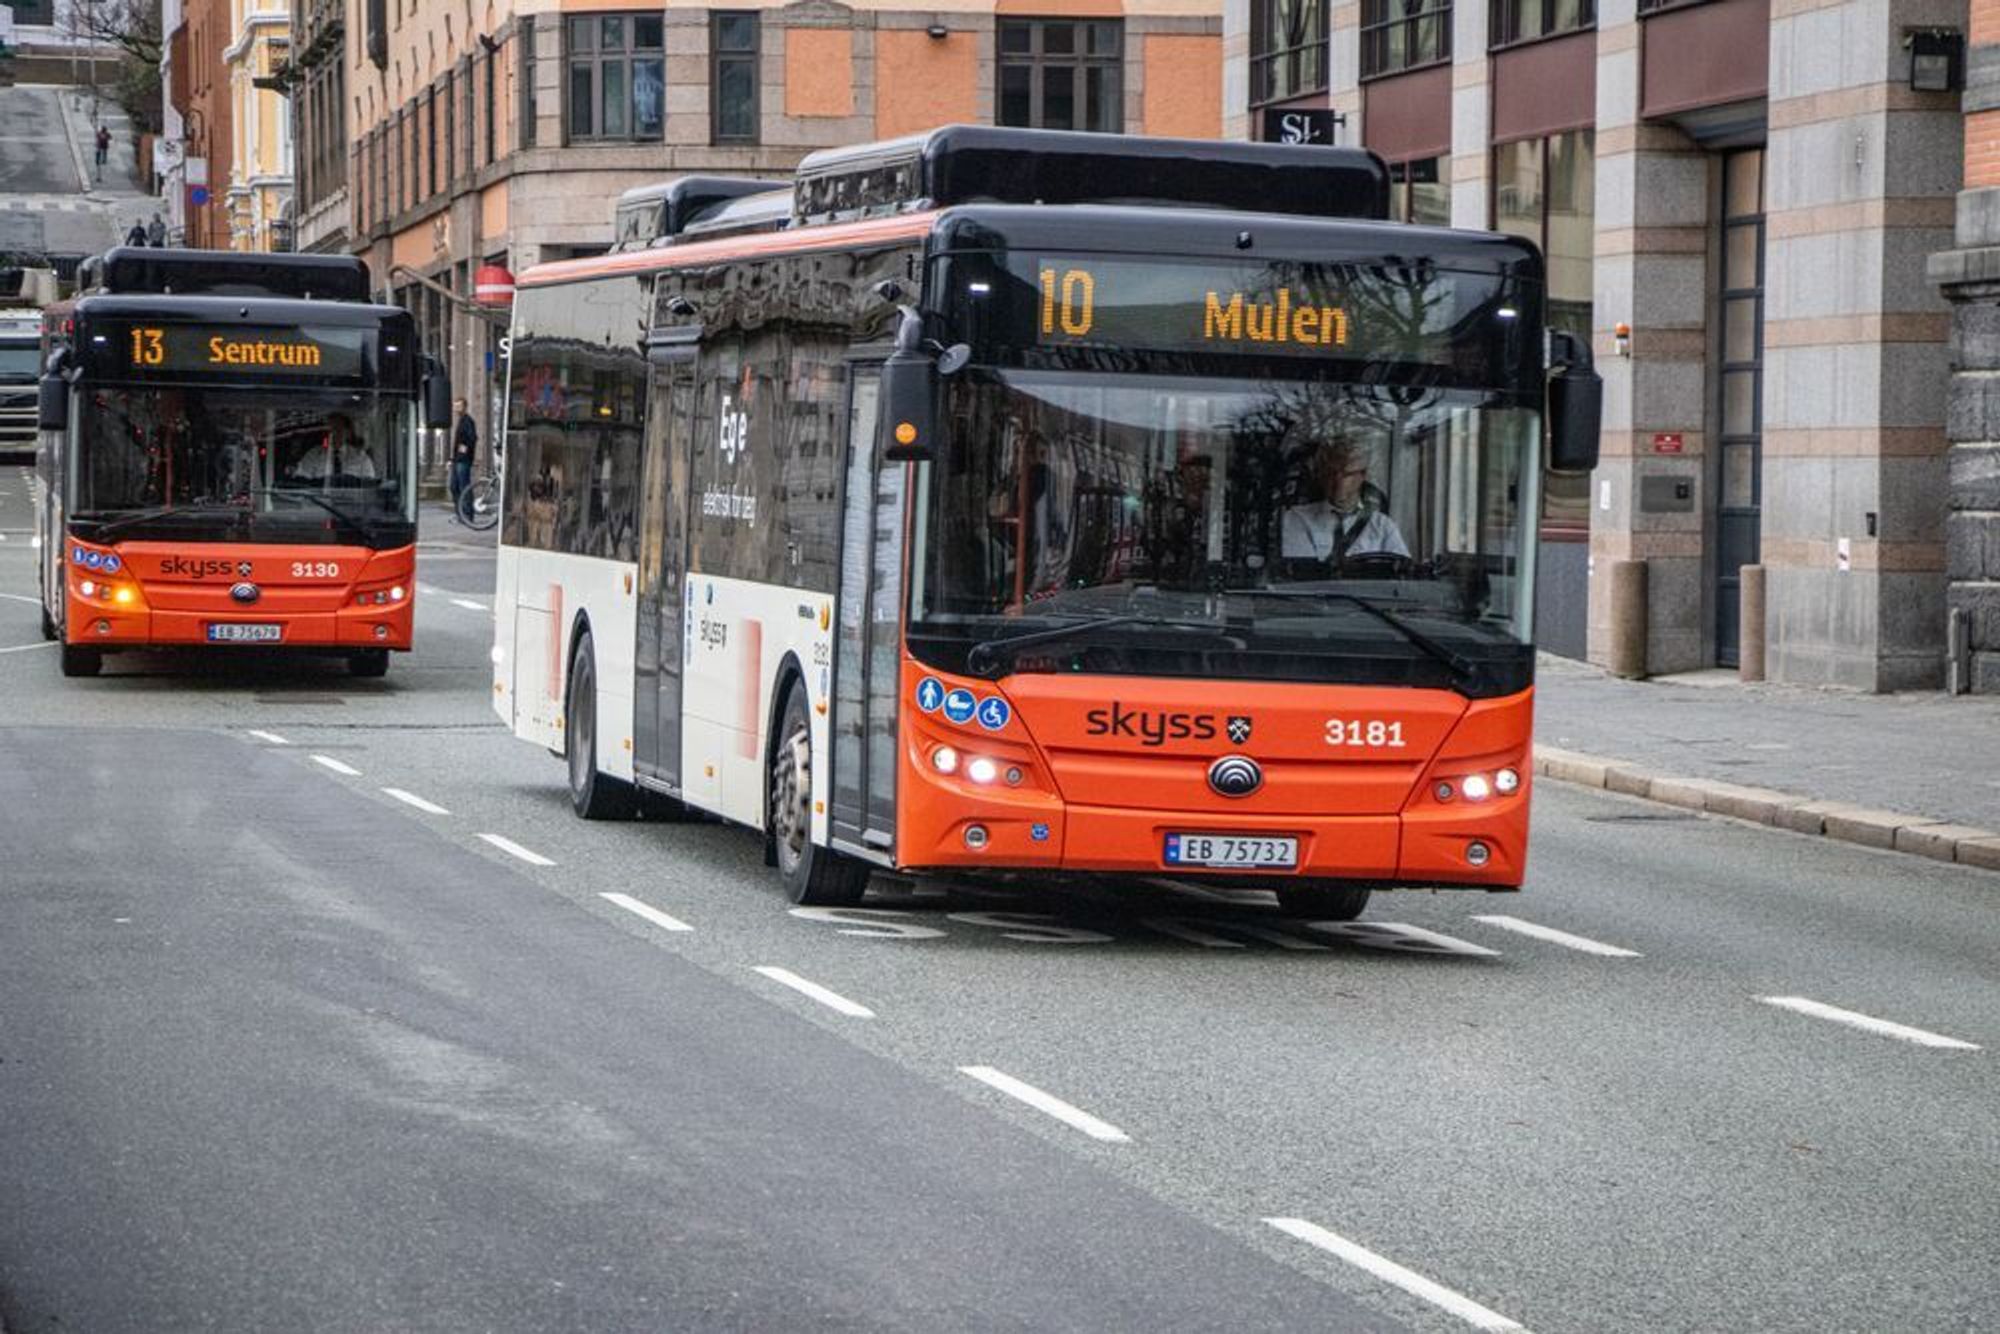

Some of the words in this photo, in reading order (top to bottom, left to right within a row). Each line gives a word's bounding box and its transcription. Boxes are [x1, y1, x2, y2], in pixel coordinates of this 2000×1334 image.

[1039, 268, 1094, 336] 10
[1204, 288, 1348, 346] Mulen
[131, 329, 164, 364] 13
[208, 336, 320, 366] Sentrum
[160, 555, 234, 579] skyss
[292, 562, 339, 578] 3130
[1086, 701, 1216, 745] skyss
[1324, 719, 1406, 747] 3181
[1186, 838, 1214, 860] EB
[1222, 840, 1289, 863] 75732
